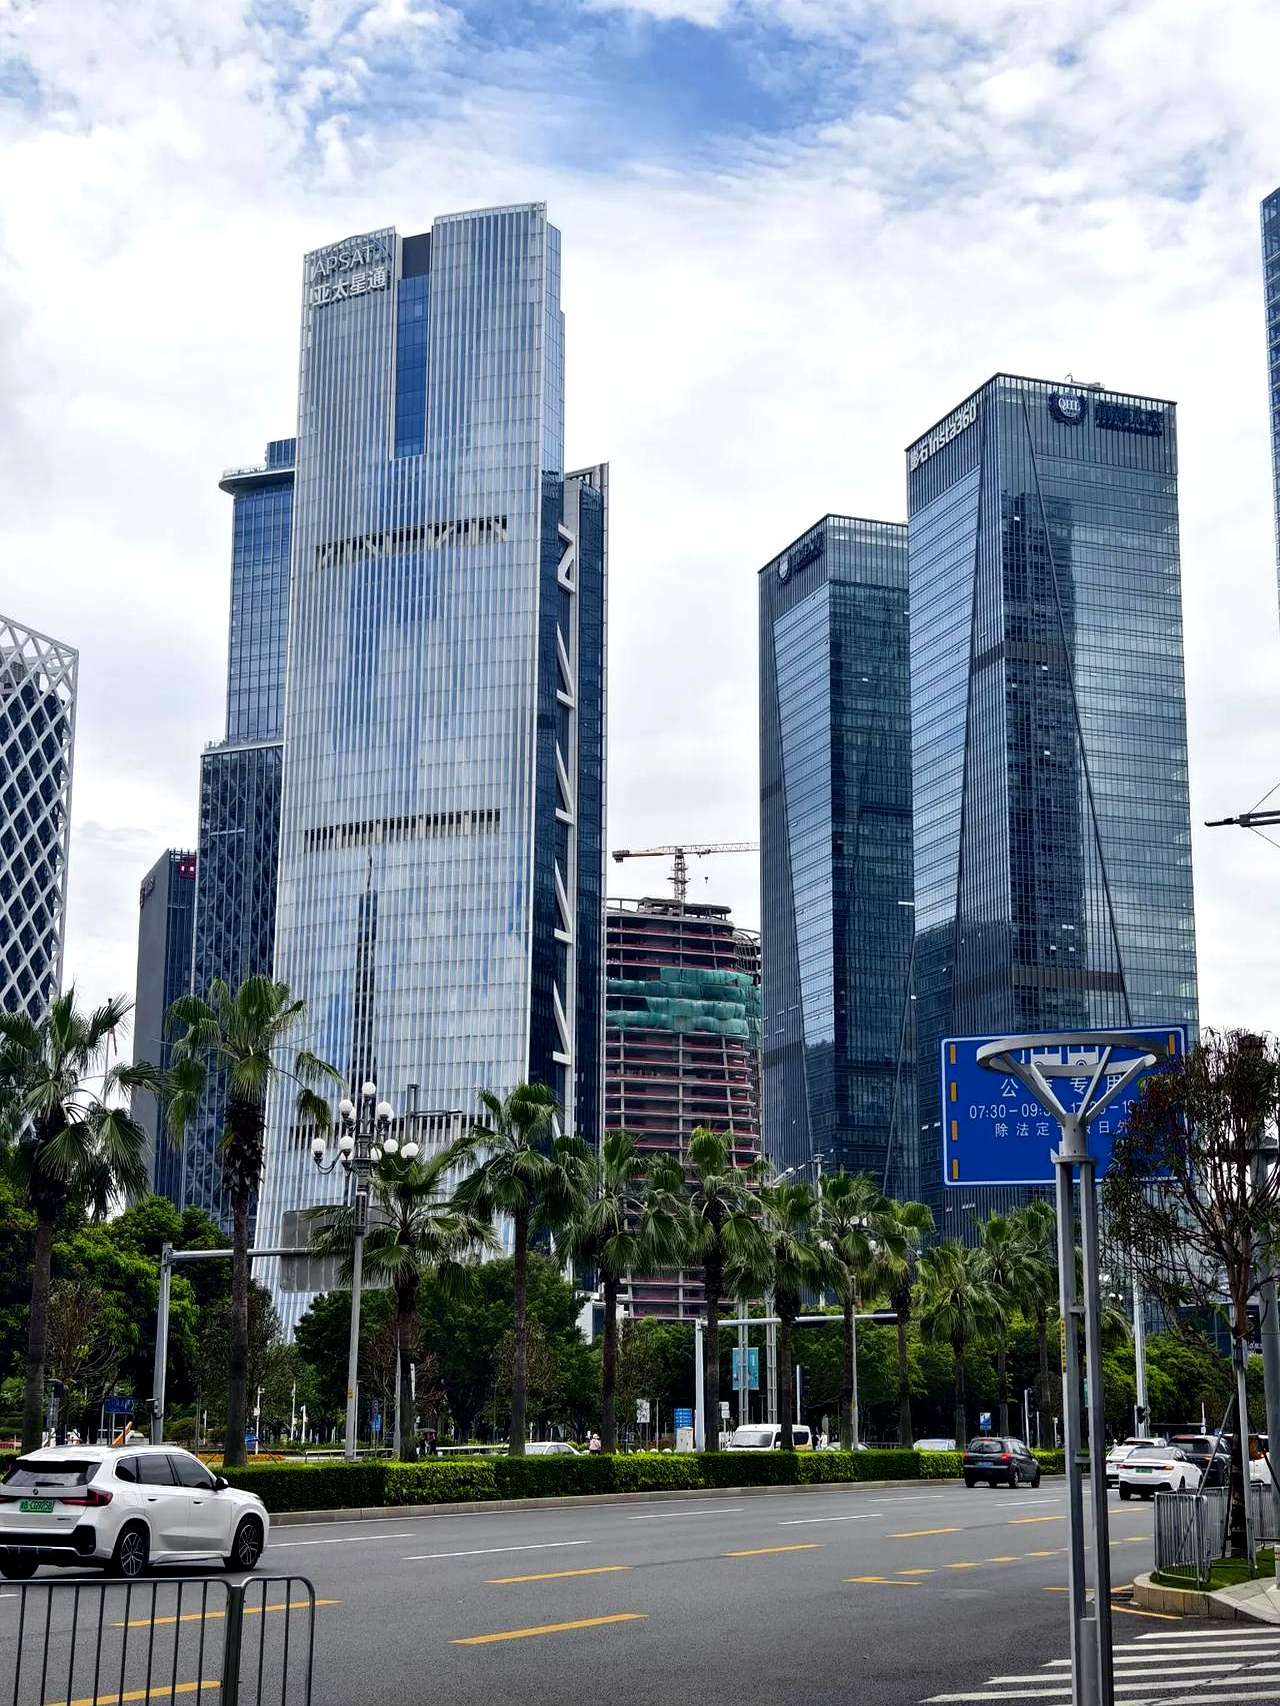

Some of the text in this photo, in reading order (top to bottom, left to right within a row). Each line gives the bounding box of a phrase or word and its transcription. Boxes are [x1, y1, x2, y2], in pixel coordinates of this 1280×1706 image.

[312, 245, 373, 279] APSAT
[312, 267, 386, 305] 亚太星通
